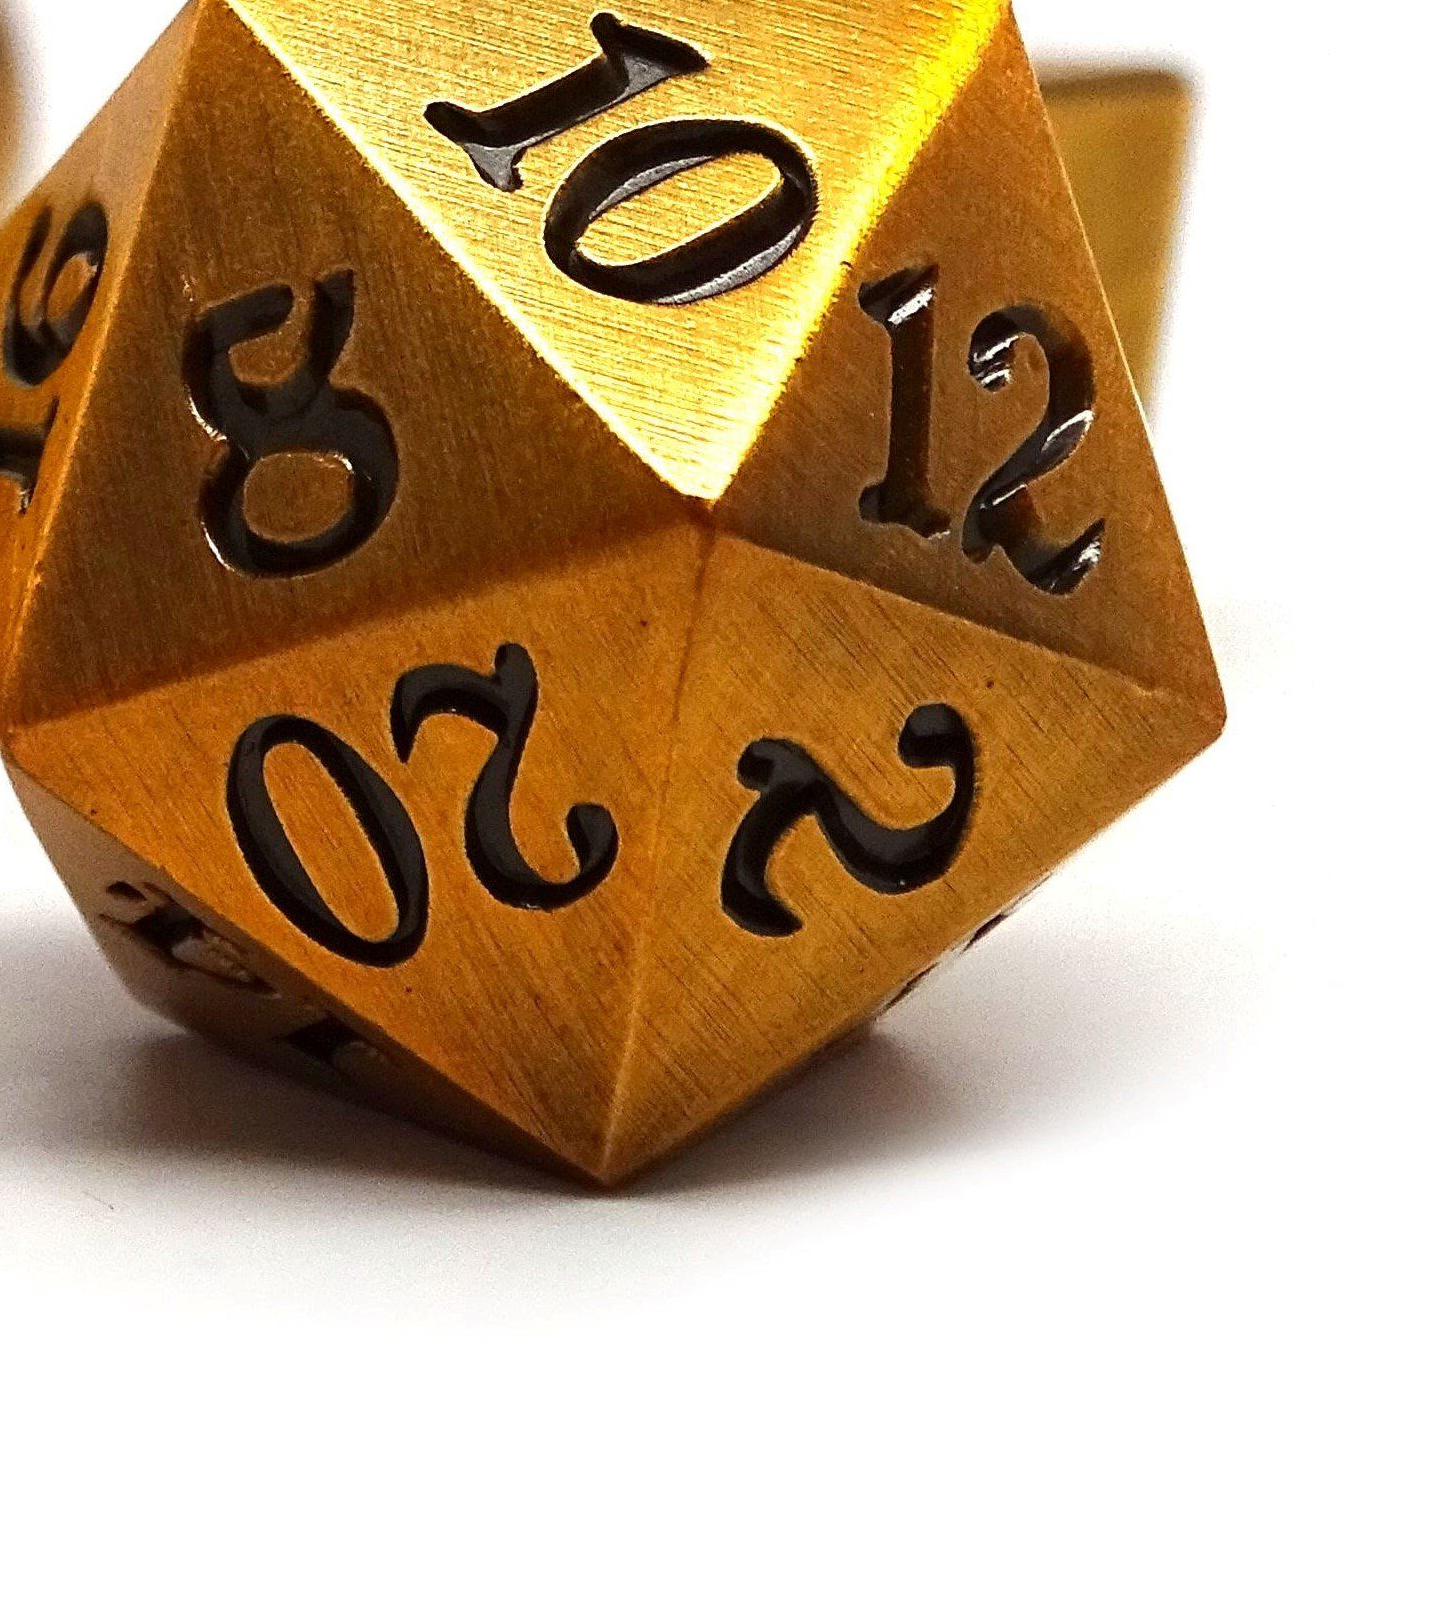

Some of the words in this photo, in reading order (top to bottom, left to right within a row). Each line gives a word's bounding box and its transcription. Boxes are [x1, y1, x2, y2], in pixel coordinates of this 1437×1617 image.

[423, 12, 819, 305] 10
[181, 268, 399, 580] 8
[857, 263, 1107, 595] 12
[225, 643, 620, 969] 20
[723, 703, 977, 938] 2
